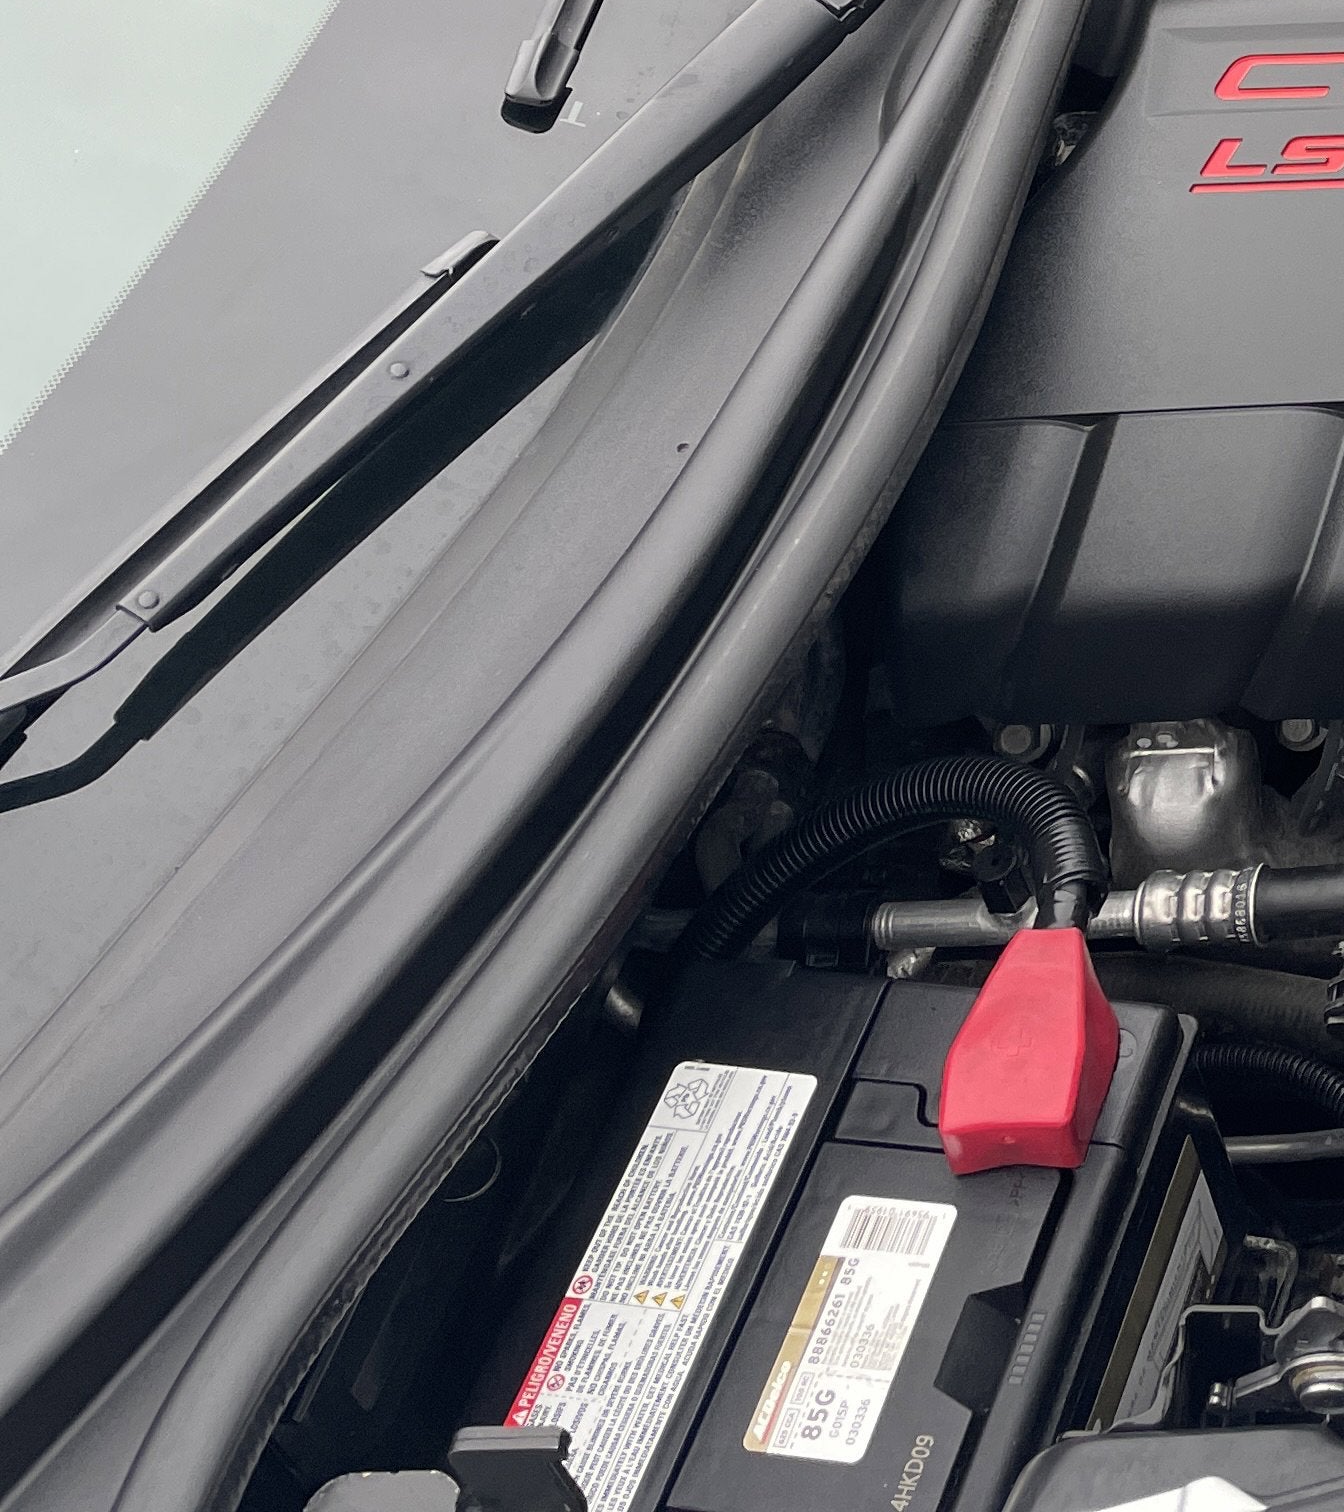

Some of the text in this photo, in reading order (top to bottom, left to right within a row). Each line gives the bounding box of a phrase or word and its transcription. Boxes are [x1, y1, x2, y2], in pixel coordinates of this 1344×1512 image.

[614, 1276, 626, 1290] PAS
[643, 1215, 655, 1228] PAS
[663, 1179, 672, 1187] LA
[652, 1222, 661, 1231] LA
[605, 1274, 617, 1288] NOT
[625, 1231, 637, 1245] NOT
[807, 1293, 846, 1364] 88866261
[839, 1257, 860, 1285] 85G
[517, 1303, 579, 1407] PELIGRO/VENENO
[848, 1323, 876, 1368] 030336
[564, 1376, 579, 1391] PAS
[798, 1388, 837, 1440] 85G
[843, 1398, 872, 1445] 030336
